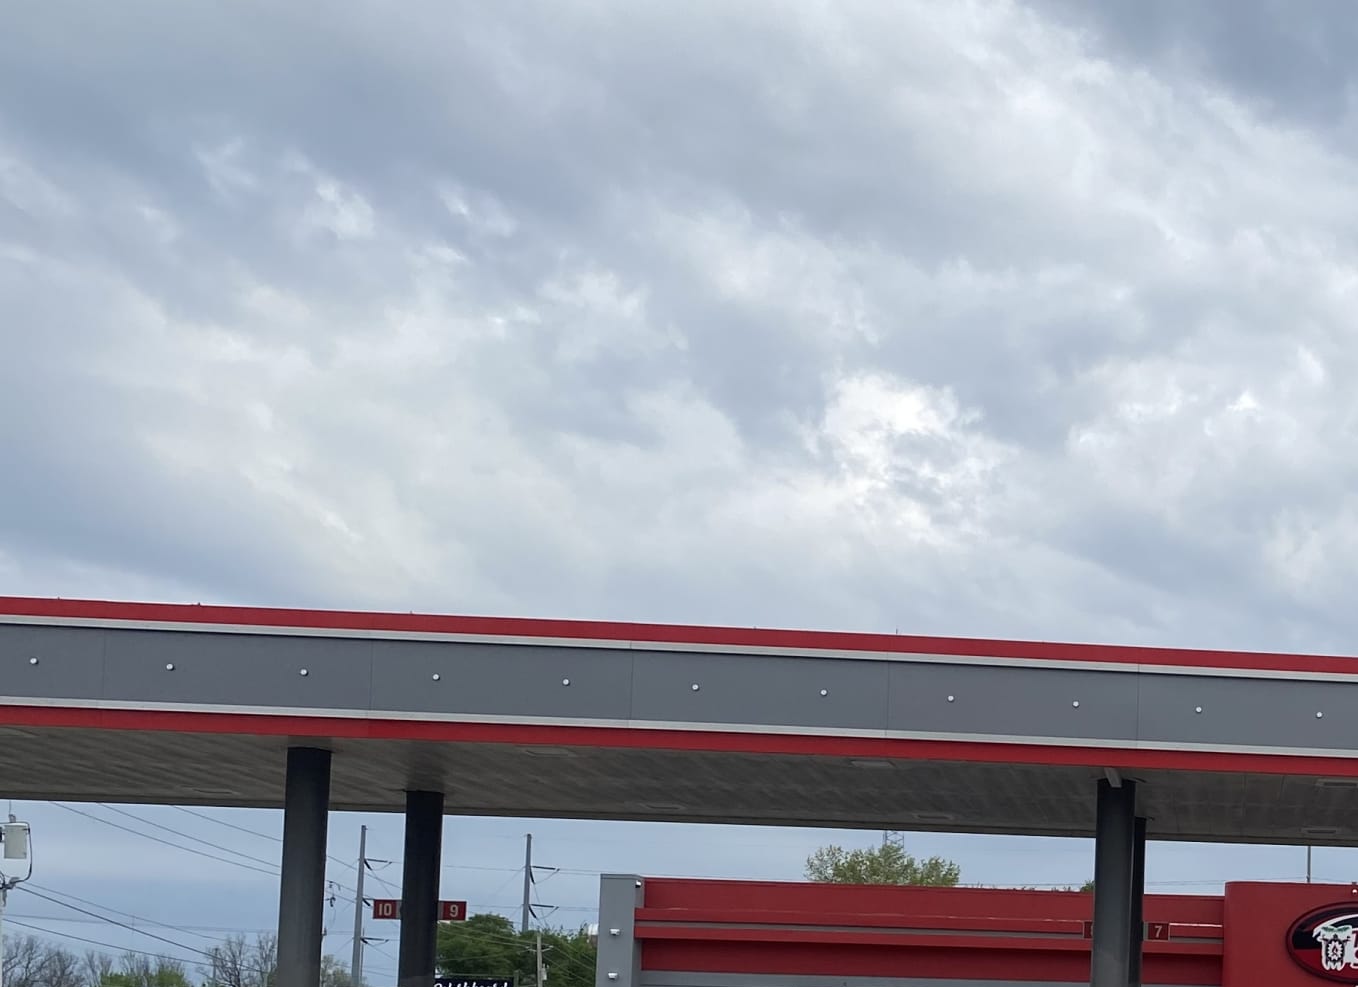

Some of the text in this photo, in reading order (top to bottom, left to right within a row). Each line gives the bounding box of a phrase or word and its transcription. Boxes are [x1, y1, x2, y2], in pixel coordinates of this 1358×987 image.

[379, 903, 392, 916] 10
[450, 904, 459, 917] 9
[1154, 925, 1163, 938] 7
